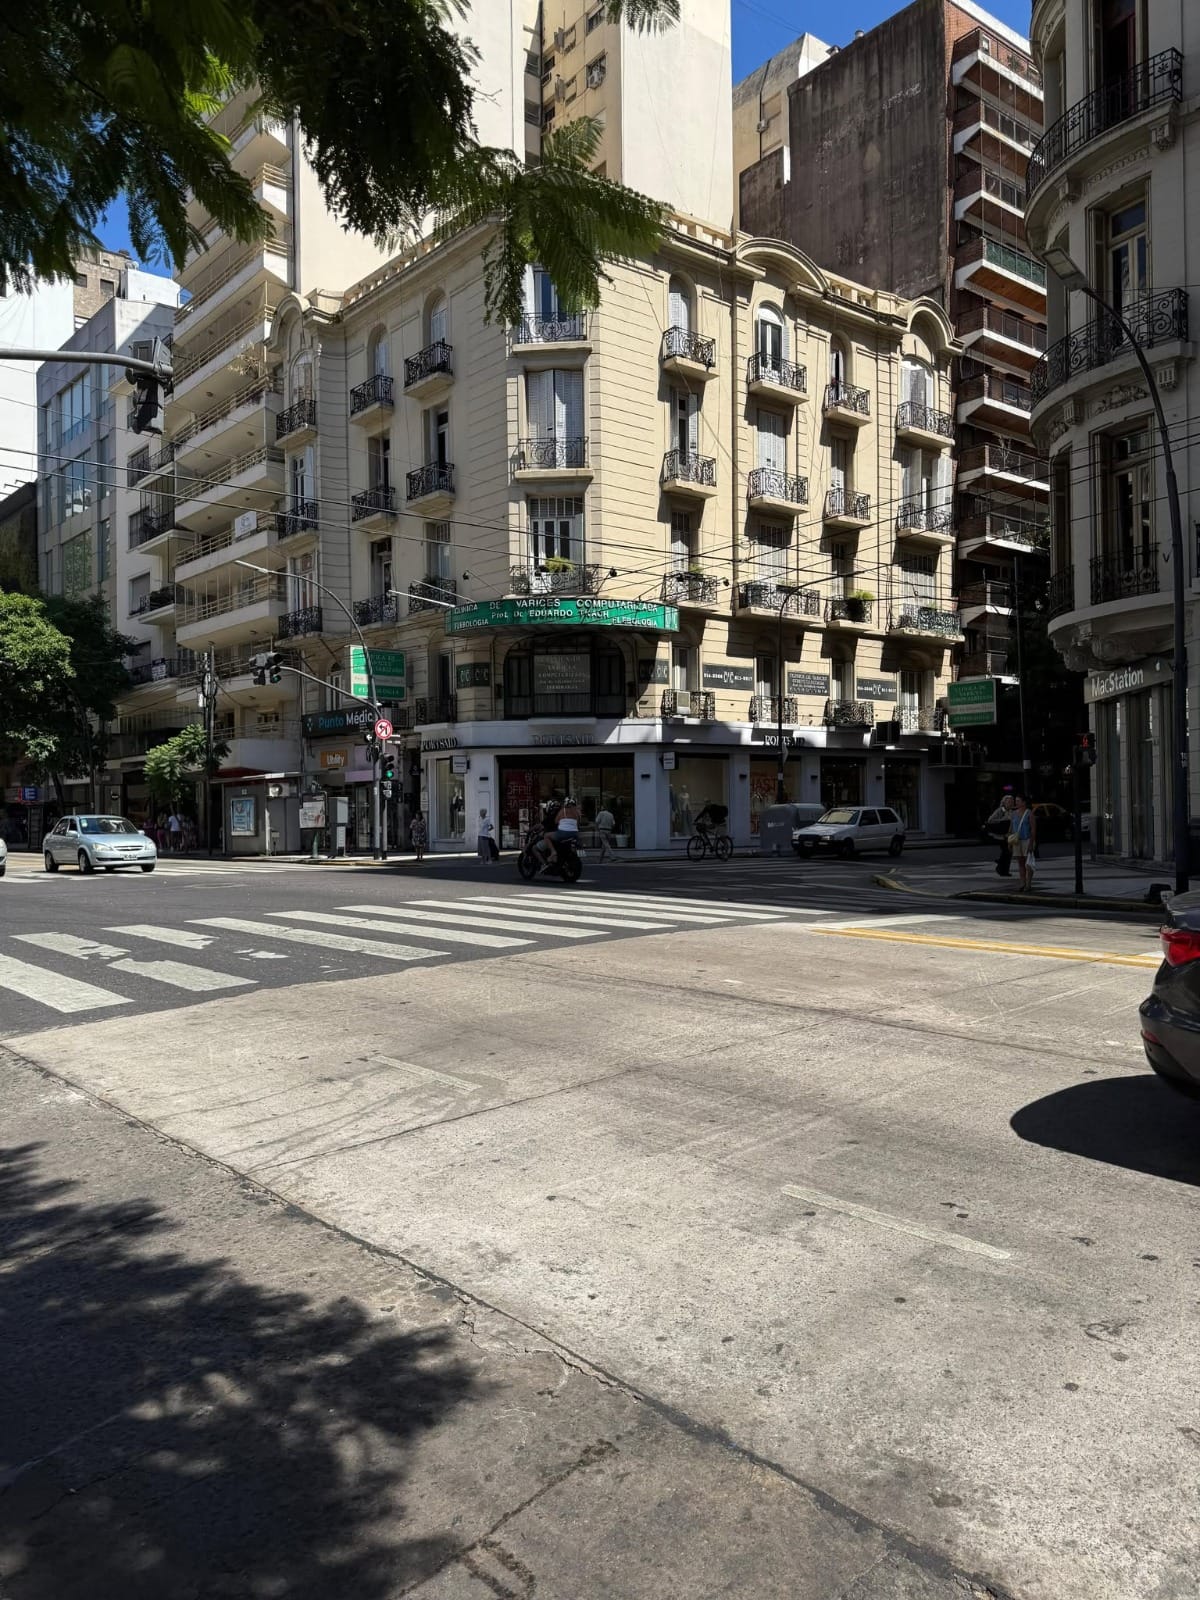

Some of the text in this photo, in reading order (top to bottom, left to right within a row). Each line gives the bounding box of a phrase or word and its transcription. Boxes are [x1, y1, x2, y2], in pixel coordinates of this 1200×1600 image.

[489, 601, 502, 610] DE
[516, 598, 561, 608] VARICES
[529, 609, 573, 618] EDUARDO
[1091, 666, 1144, 697] MacStation
[318, 716, 344, 728] Punto
